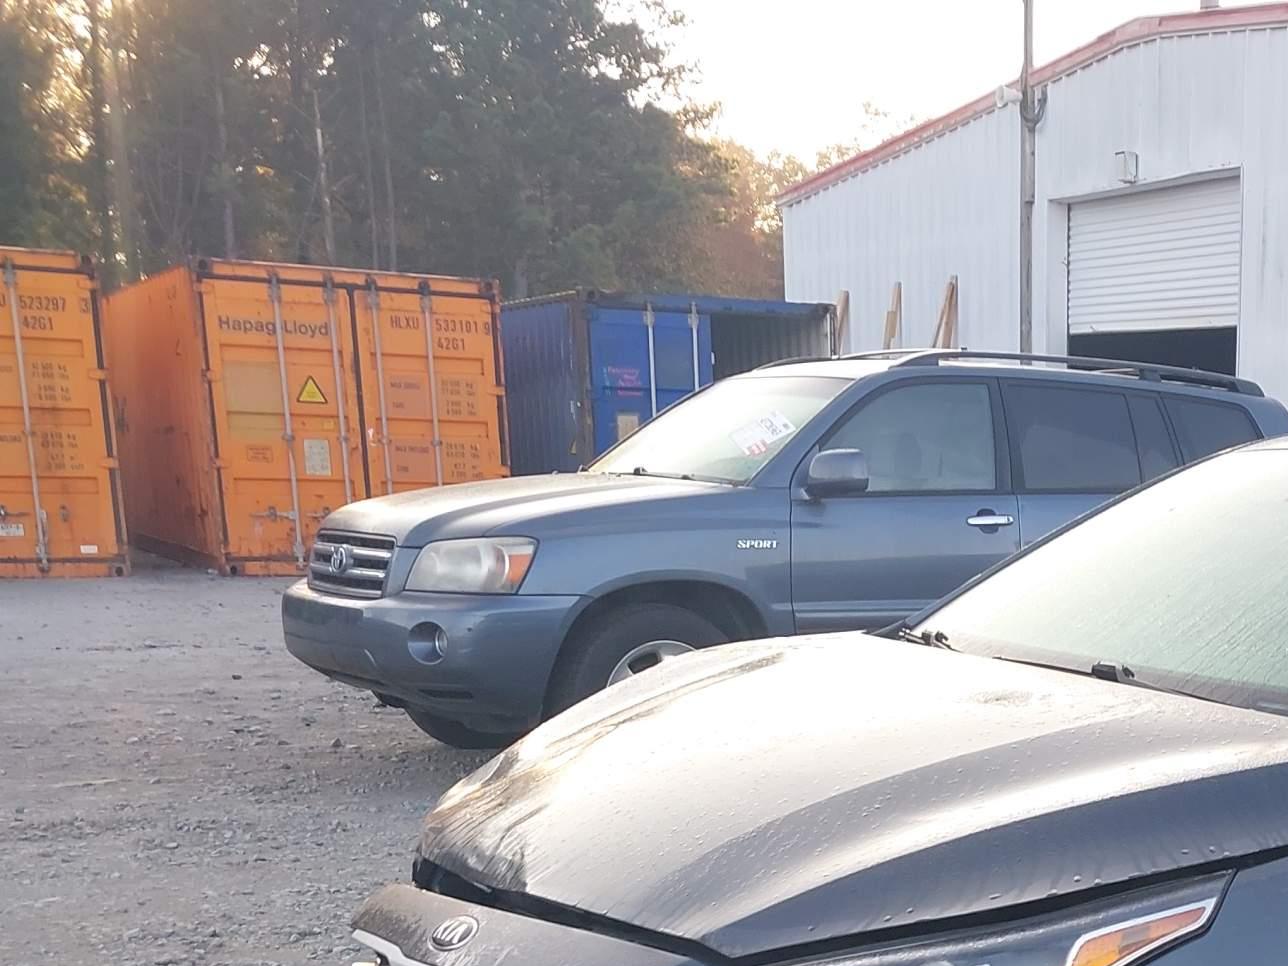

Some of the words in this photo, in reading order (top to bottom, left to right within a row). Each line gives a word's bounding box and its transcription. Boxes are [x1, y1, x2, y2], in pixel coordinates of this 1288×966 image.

[19, 295, 66, 312] 523297
[22, 315, 54, 331] 42G1
[217, 316, 329, 338] HapagLloyd
[390, 315, 420, 329] HLXU
[434, 318, 479, 333] 533101
[483, 321, 491, 335] 9
[436, 337, 466, 350] 42G1
[737, 539, 777, 549] SPORT
